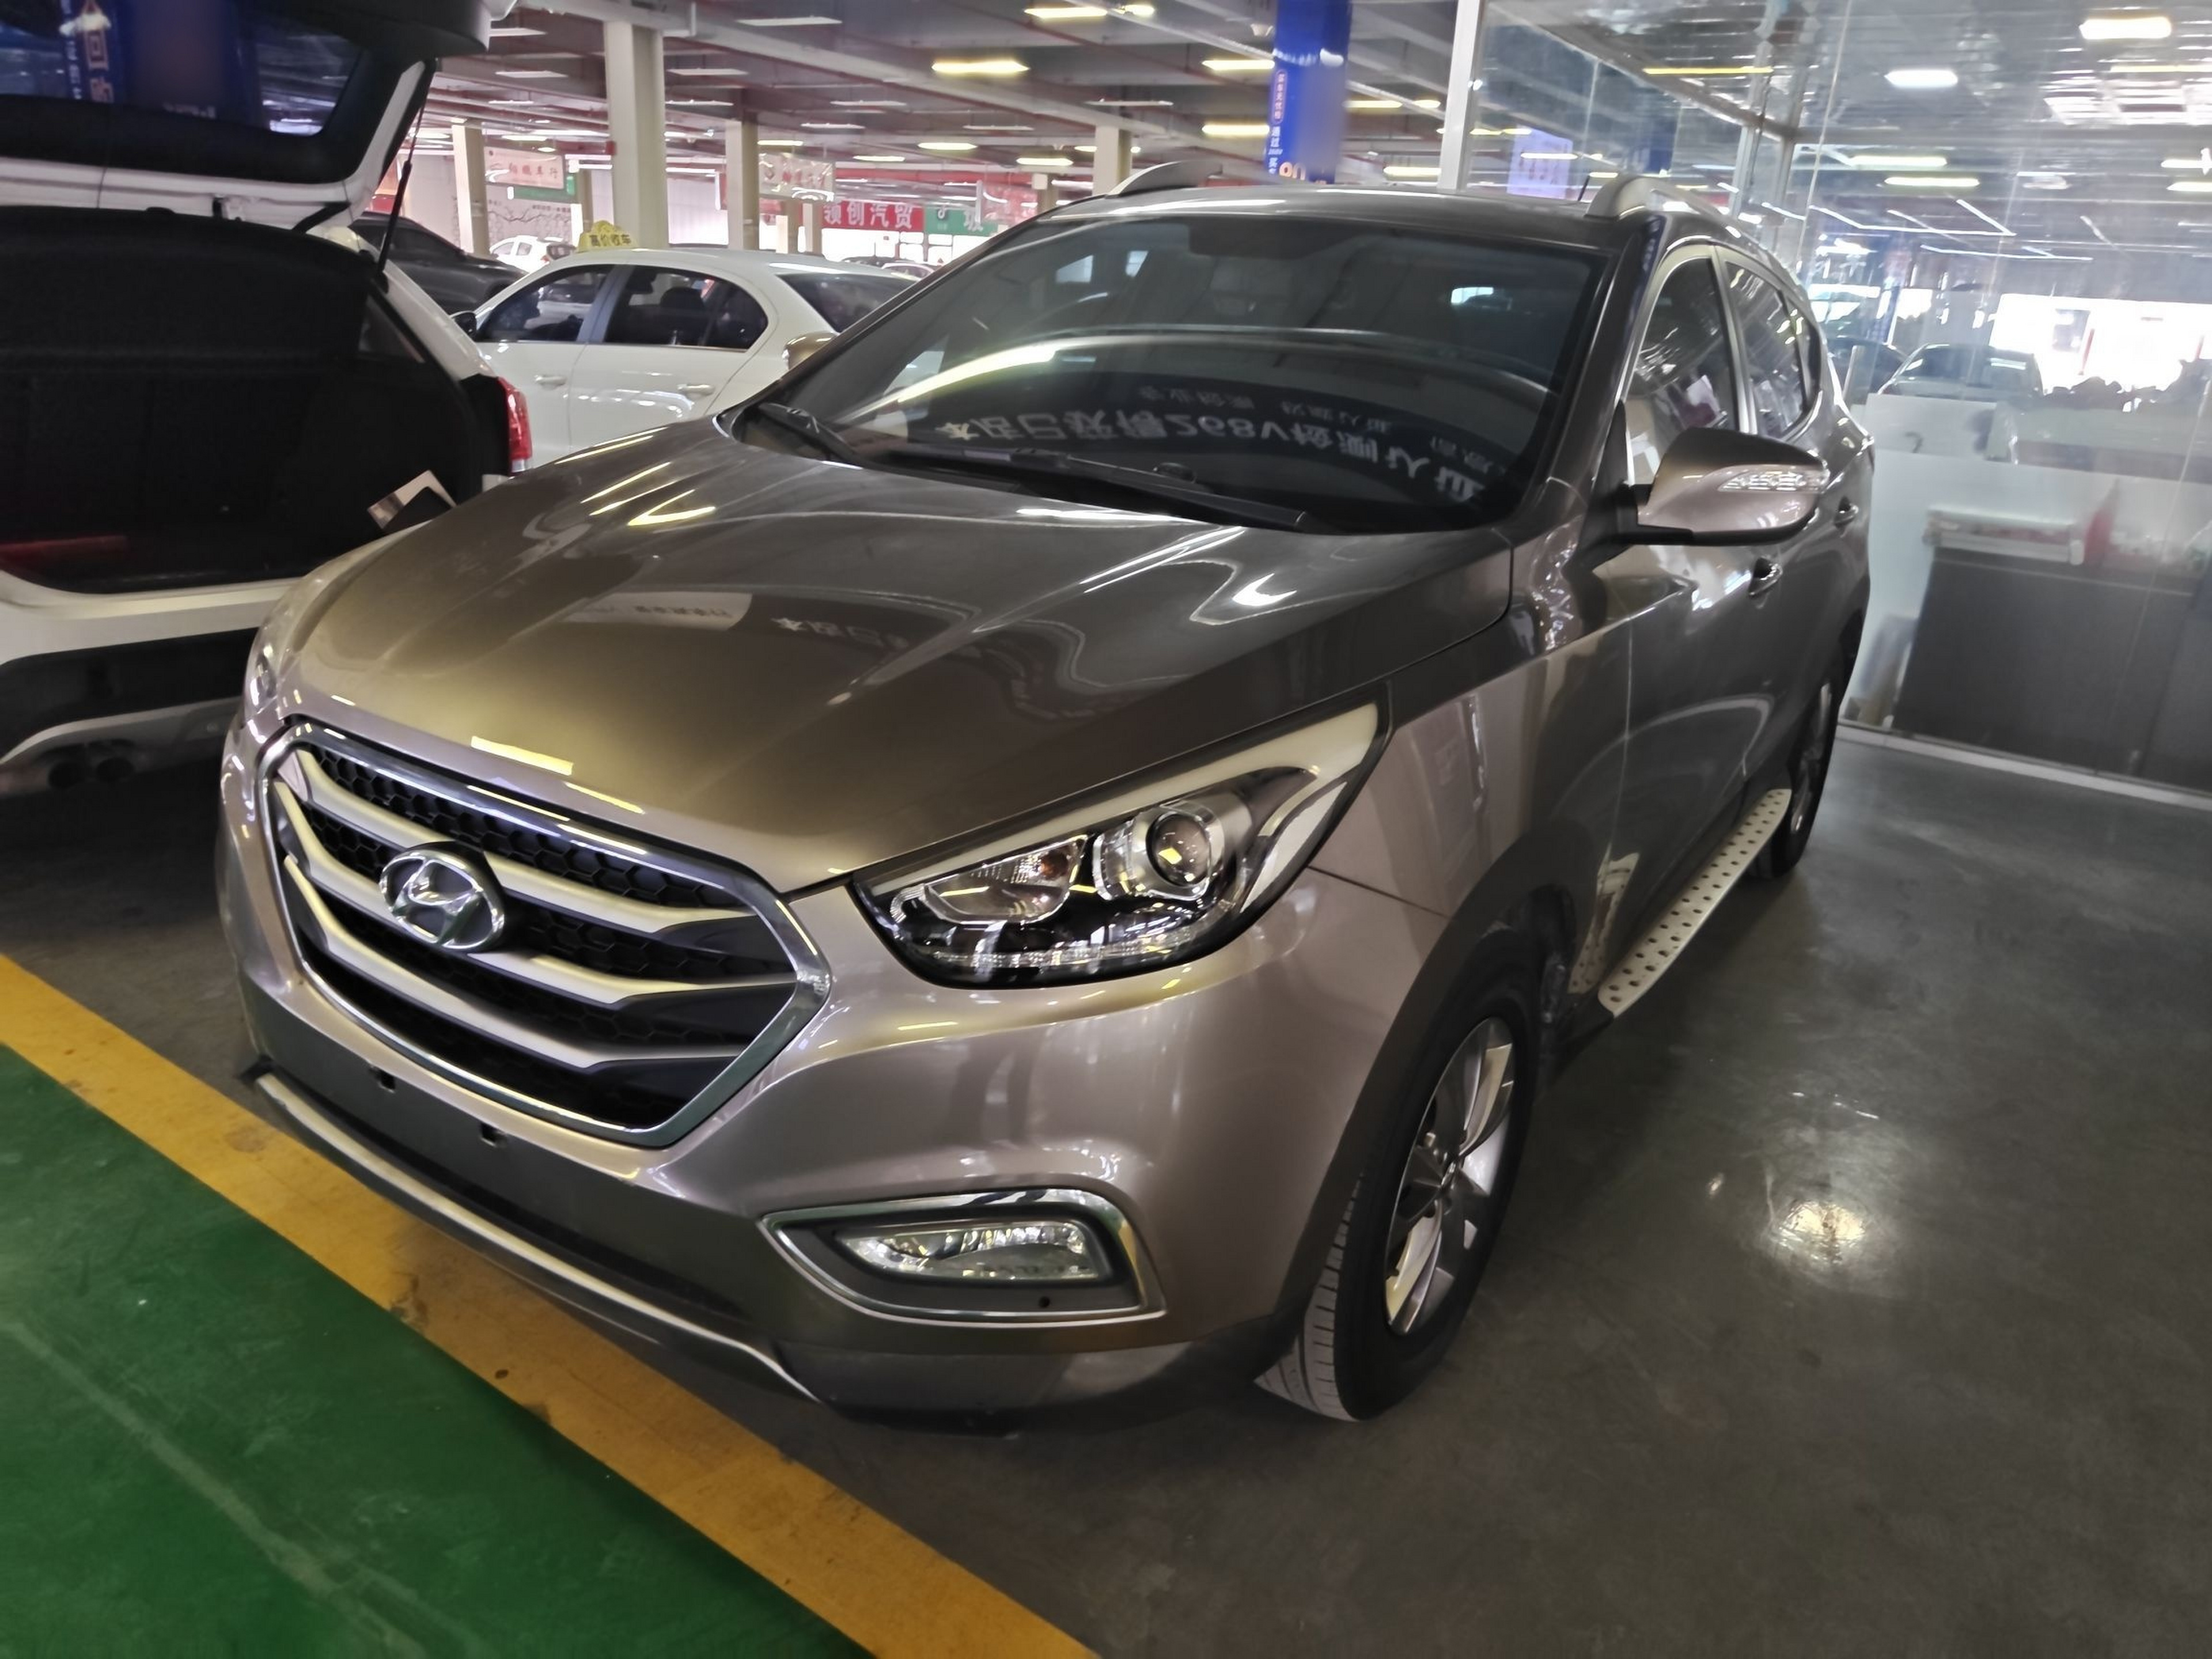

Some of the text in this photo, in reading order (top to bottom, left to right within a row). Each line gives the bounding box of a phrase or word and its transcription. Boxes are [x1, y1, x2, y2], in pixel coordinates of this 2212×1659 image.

[823, 201, 912, 229] 领创汽贸
[589, 234, 631, 247] 高价收车
